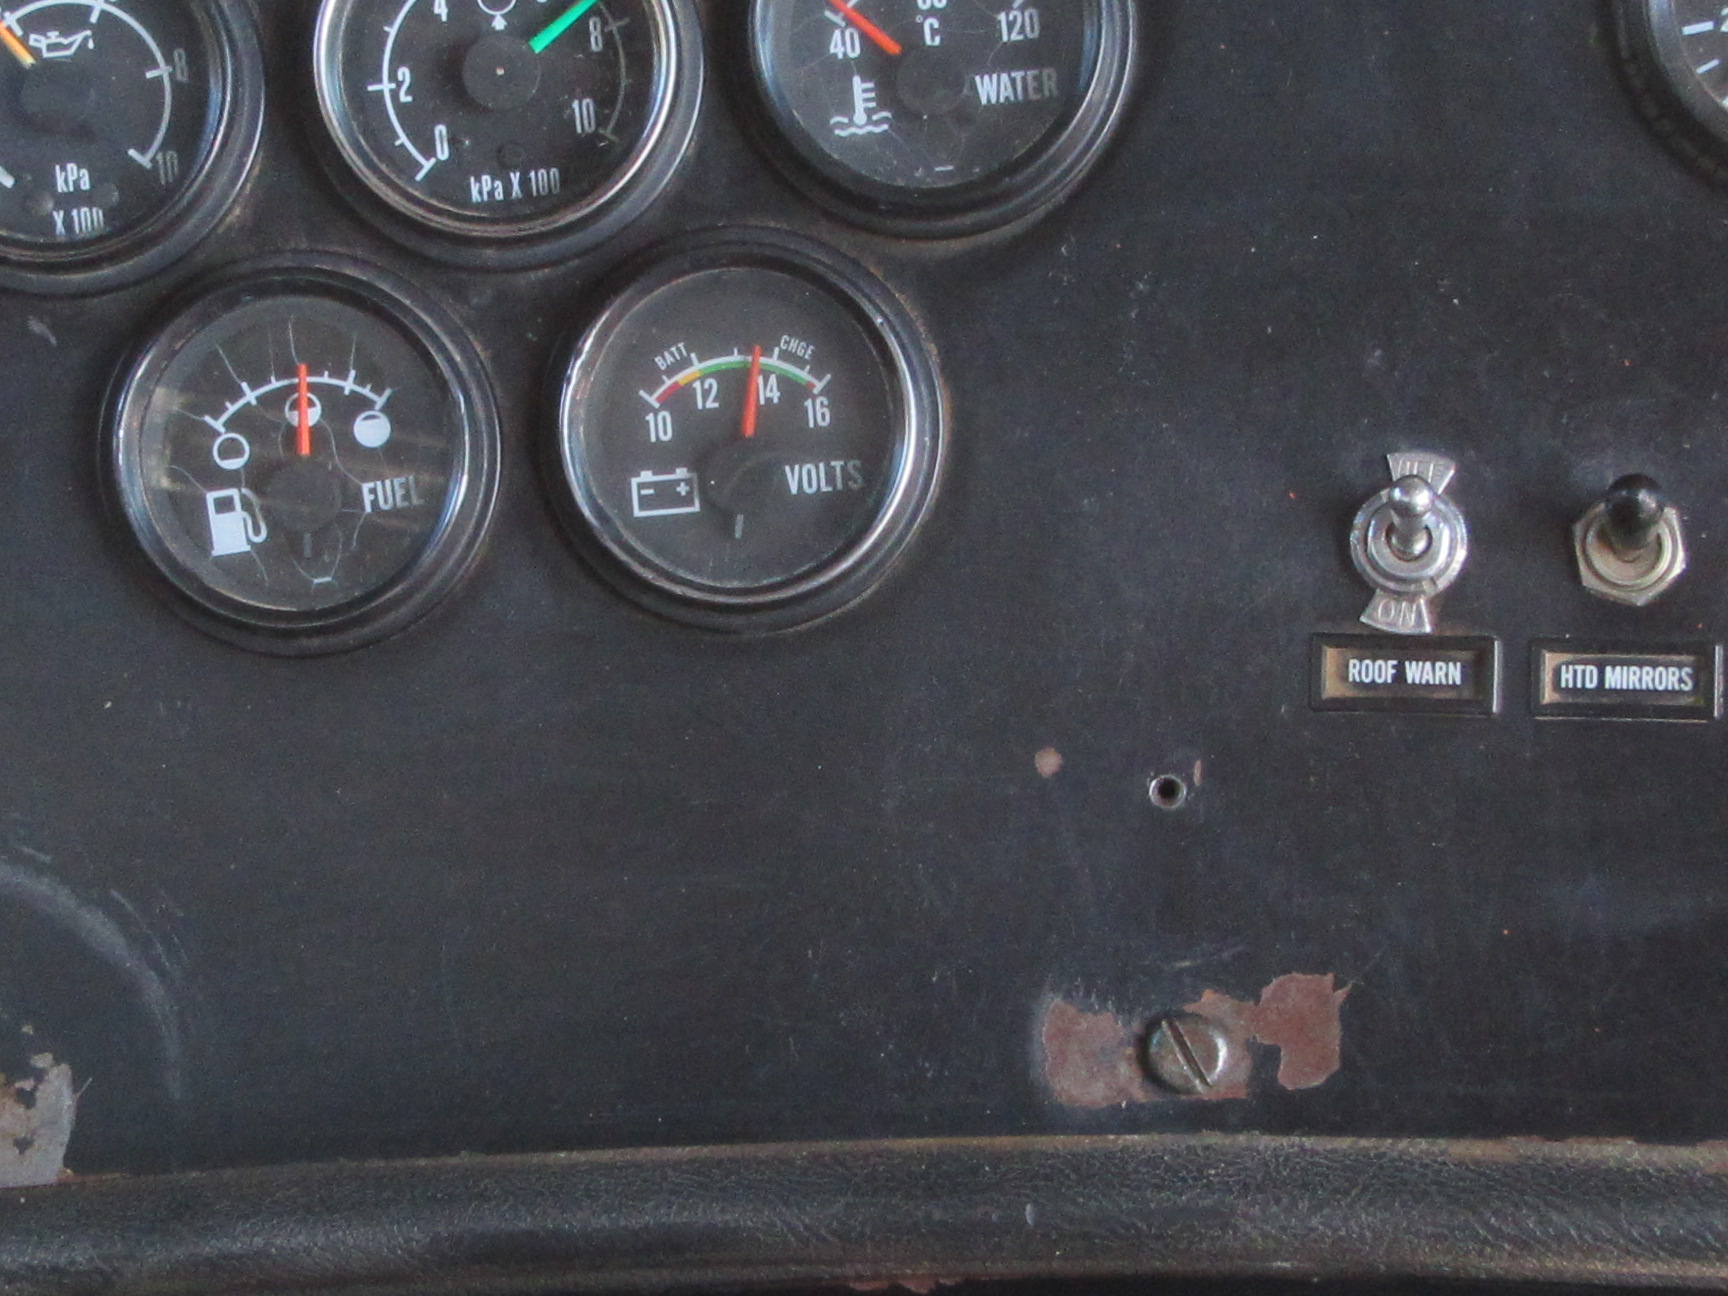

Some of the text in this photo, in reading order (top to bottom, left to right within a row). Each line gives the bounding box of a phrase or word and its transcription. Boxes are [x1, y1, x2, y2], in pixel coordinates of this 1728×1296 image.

[589, 16, 603, 52] 8
[915, 14, 941, 46] °C
[997, 8, 1041, 43] 120
[829, 27, 861, 60] 40
[172, 48, 189, 83] 8
[397, 66, 413, 103] 2
[975, 67, 1058, 105] WATER
[572, 98, 596, 134] 10
[434, 124, 450, 161] 0
[54, 162, 91, 193] kPa
[156, 150, 180, 186] 10
[470, 167, 561, 203] kPa X 100
[53, 206, 104, 236] X 100
[654, 341, 689, 371] BATT
[779, 334, 816, 361] CHGE
[691, 378, 720, 411] 12
[758, 373, 781, 405] 14
[645, 410, 673, 443] 10
[804, 396, 831, 429] 16
[361, 475, 423, 513] FUEL
[784, 459, 864, 496] VOLTS
[1377, 600, 1416, 627] ON
[1348, 659, 1462, 685] ROOF WARN
[1560, 664, 1693, 692] HTD MIRRORS
